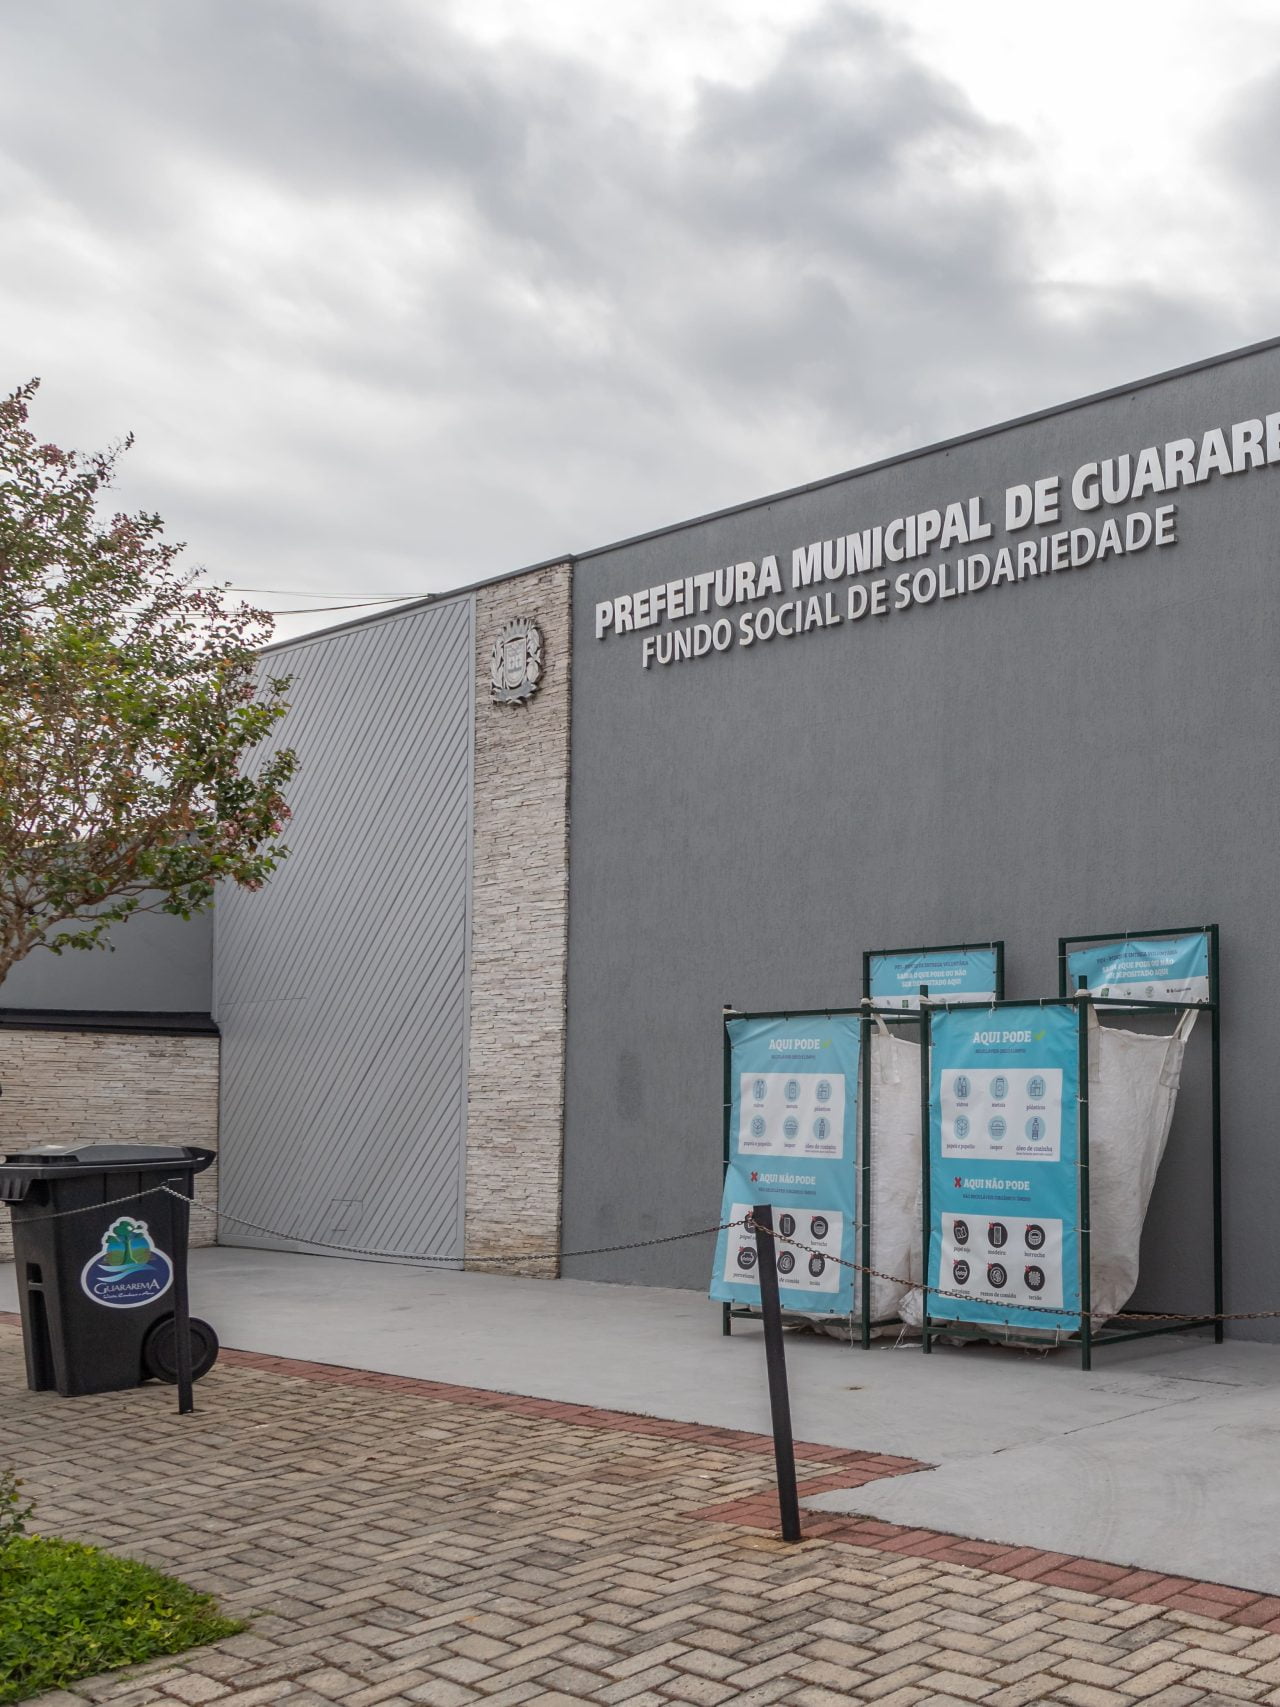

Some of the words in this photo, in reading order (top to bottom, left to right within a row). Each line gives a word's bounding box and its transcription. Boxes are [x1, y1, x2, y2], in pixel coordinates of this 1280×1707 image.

[596, 555, 783, 639] PREFEITURA
[792, 497, 993, 588] MUNICIPAL
[1005, 476, 1060, 532] DE
[642, 618, 733, 668] FUNDO
[739, 592, 842, 646] SOCIAL
[848, 579, 888, 620] DE
[895, 504, 1178, 609] SOLIDARIEDADE
[954, 968, 966, 976] NÃO
[768, 1039, 794, 1051] AQUI
[794, 1039, 820, 1050] PODE
[972, 1031, 1000, 1045] AQUI
[1001, 1031, 1031, 1043] PODE
[760, 1173, 778, 1184] AQUI
[779, 1174, 795, 1184] NÃO
[796, 1175, 816, 1185] PODE
[963, 1178, 984, 1190] AQUI
[985, 1177, 1004, 1189] NÃO
[1005, 1181, 1030, 1191] PODE
[93, 1278, 160, 1294] GUARAREMA
